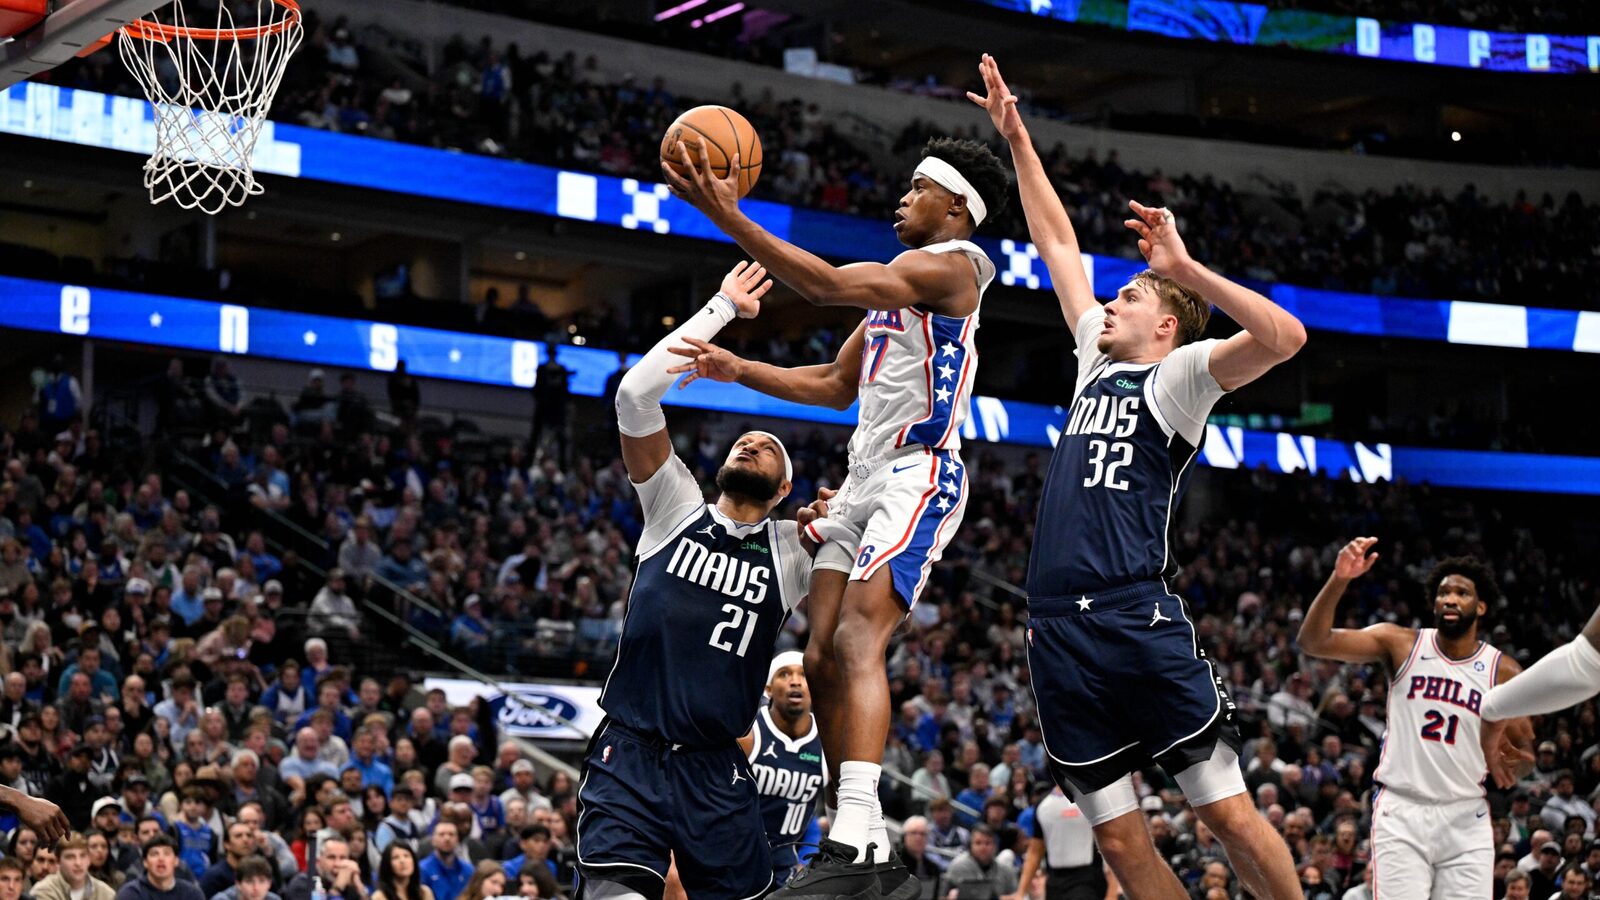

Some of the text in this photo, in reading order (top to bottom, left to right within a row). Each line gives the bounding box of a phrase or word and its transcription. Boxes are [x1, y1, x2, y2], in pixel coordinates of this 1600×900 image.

[1083, 440, 1134, 491] 32
[741, 541, 769, 554] chime
[666, 536, 770, 604] MAVS
[708, 603, 759, 658] 21
[498, 694, 565, 726] Ford
[1421, 709, 1459, 745] 21
[780, 802, 808, 835] 10
